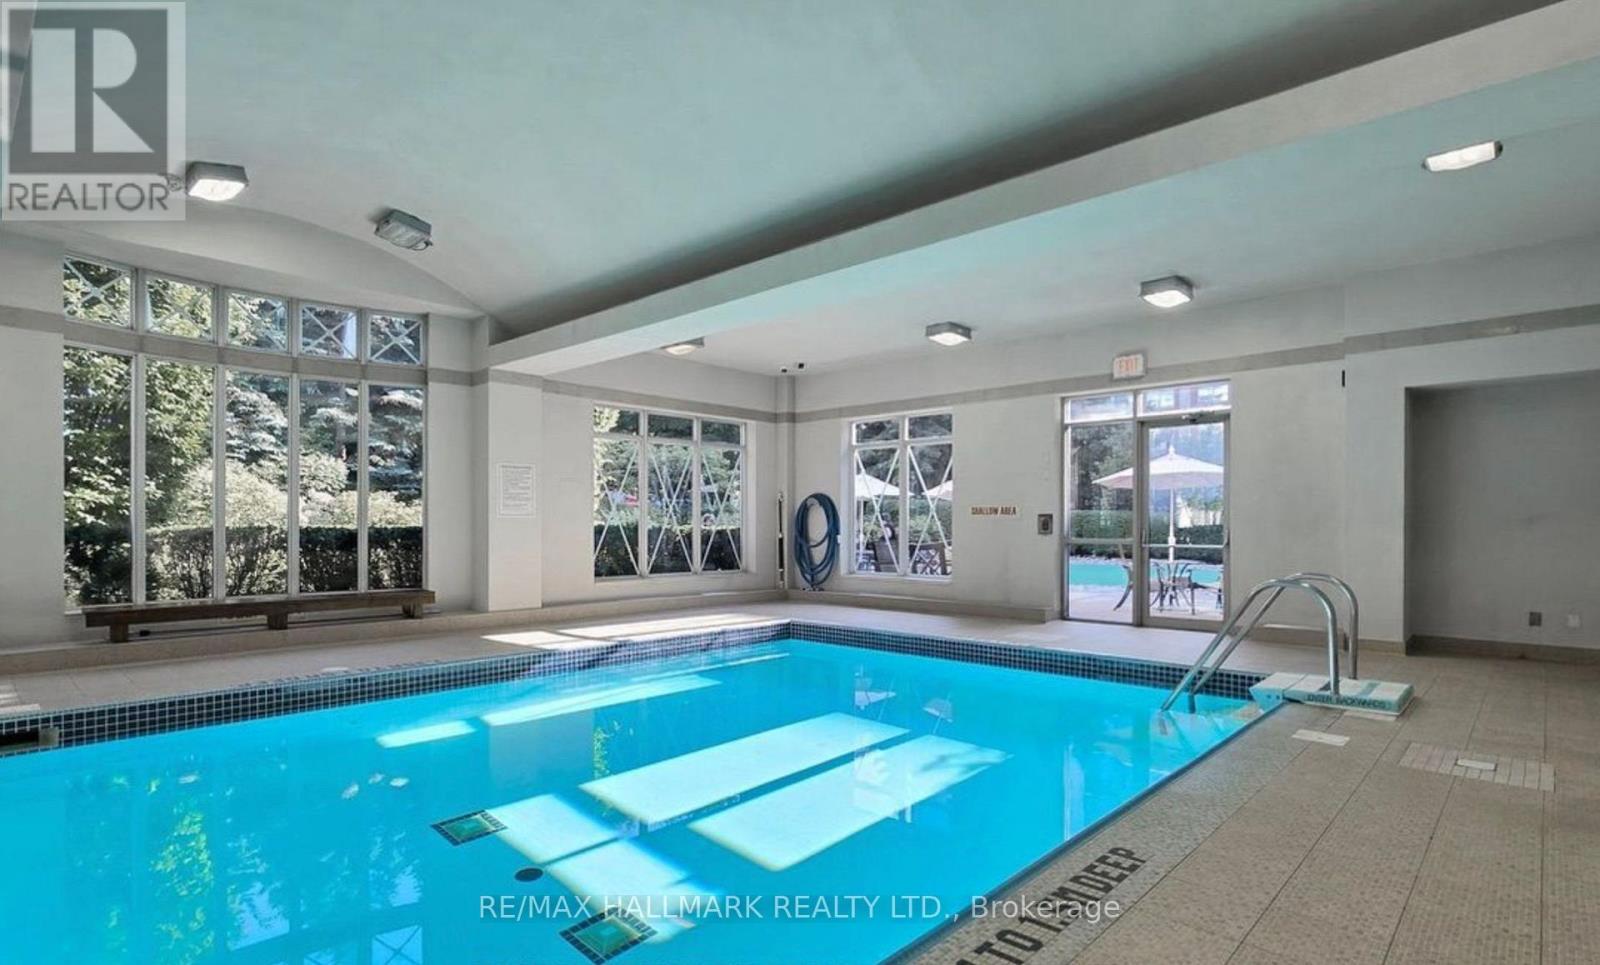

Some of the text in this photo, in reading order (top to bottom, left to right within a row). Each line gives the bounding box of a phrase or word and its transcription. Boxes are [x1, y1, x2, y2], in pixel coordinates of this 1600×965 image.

[1000, 506, 1017, 516] AREA
[973, 929, 1044, 965] TO
[1068, 846, 1147, 894] DEEP
